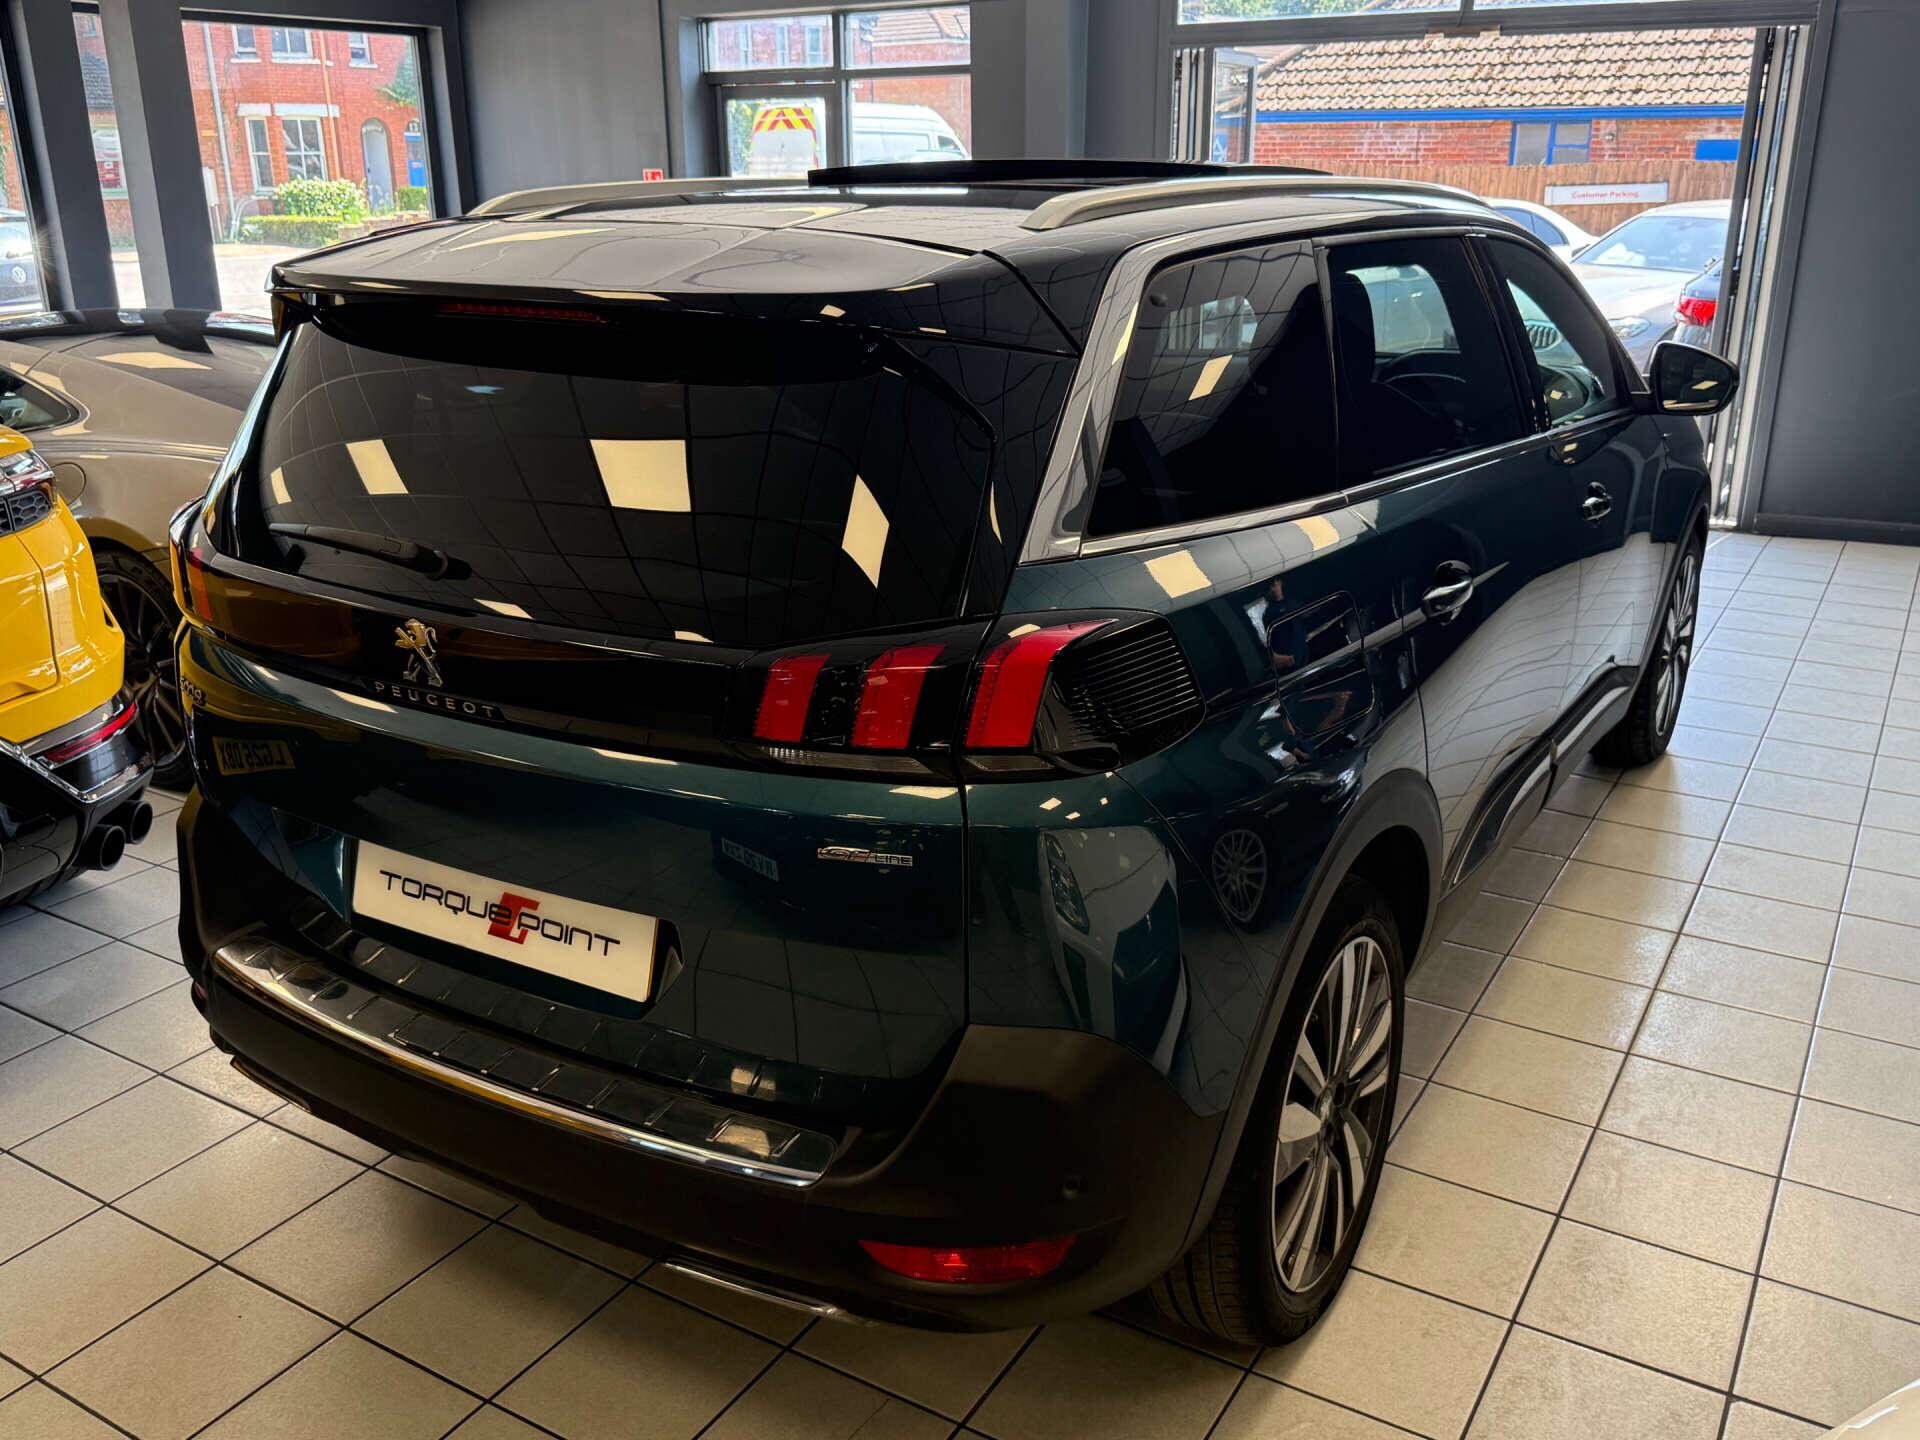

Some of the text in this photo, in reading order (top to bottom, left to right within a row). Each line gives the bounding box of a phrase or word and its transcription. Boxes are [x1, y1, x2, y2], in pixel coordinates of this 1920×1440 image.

[1571, 190, 1640, 199] Customer Parking
[374, 681, 494, 718] PEUGEOT
